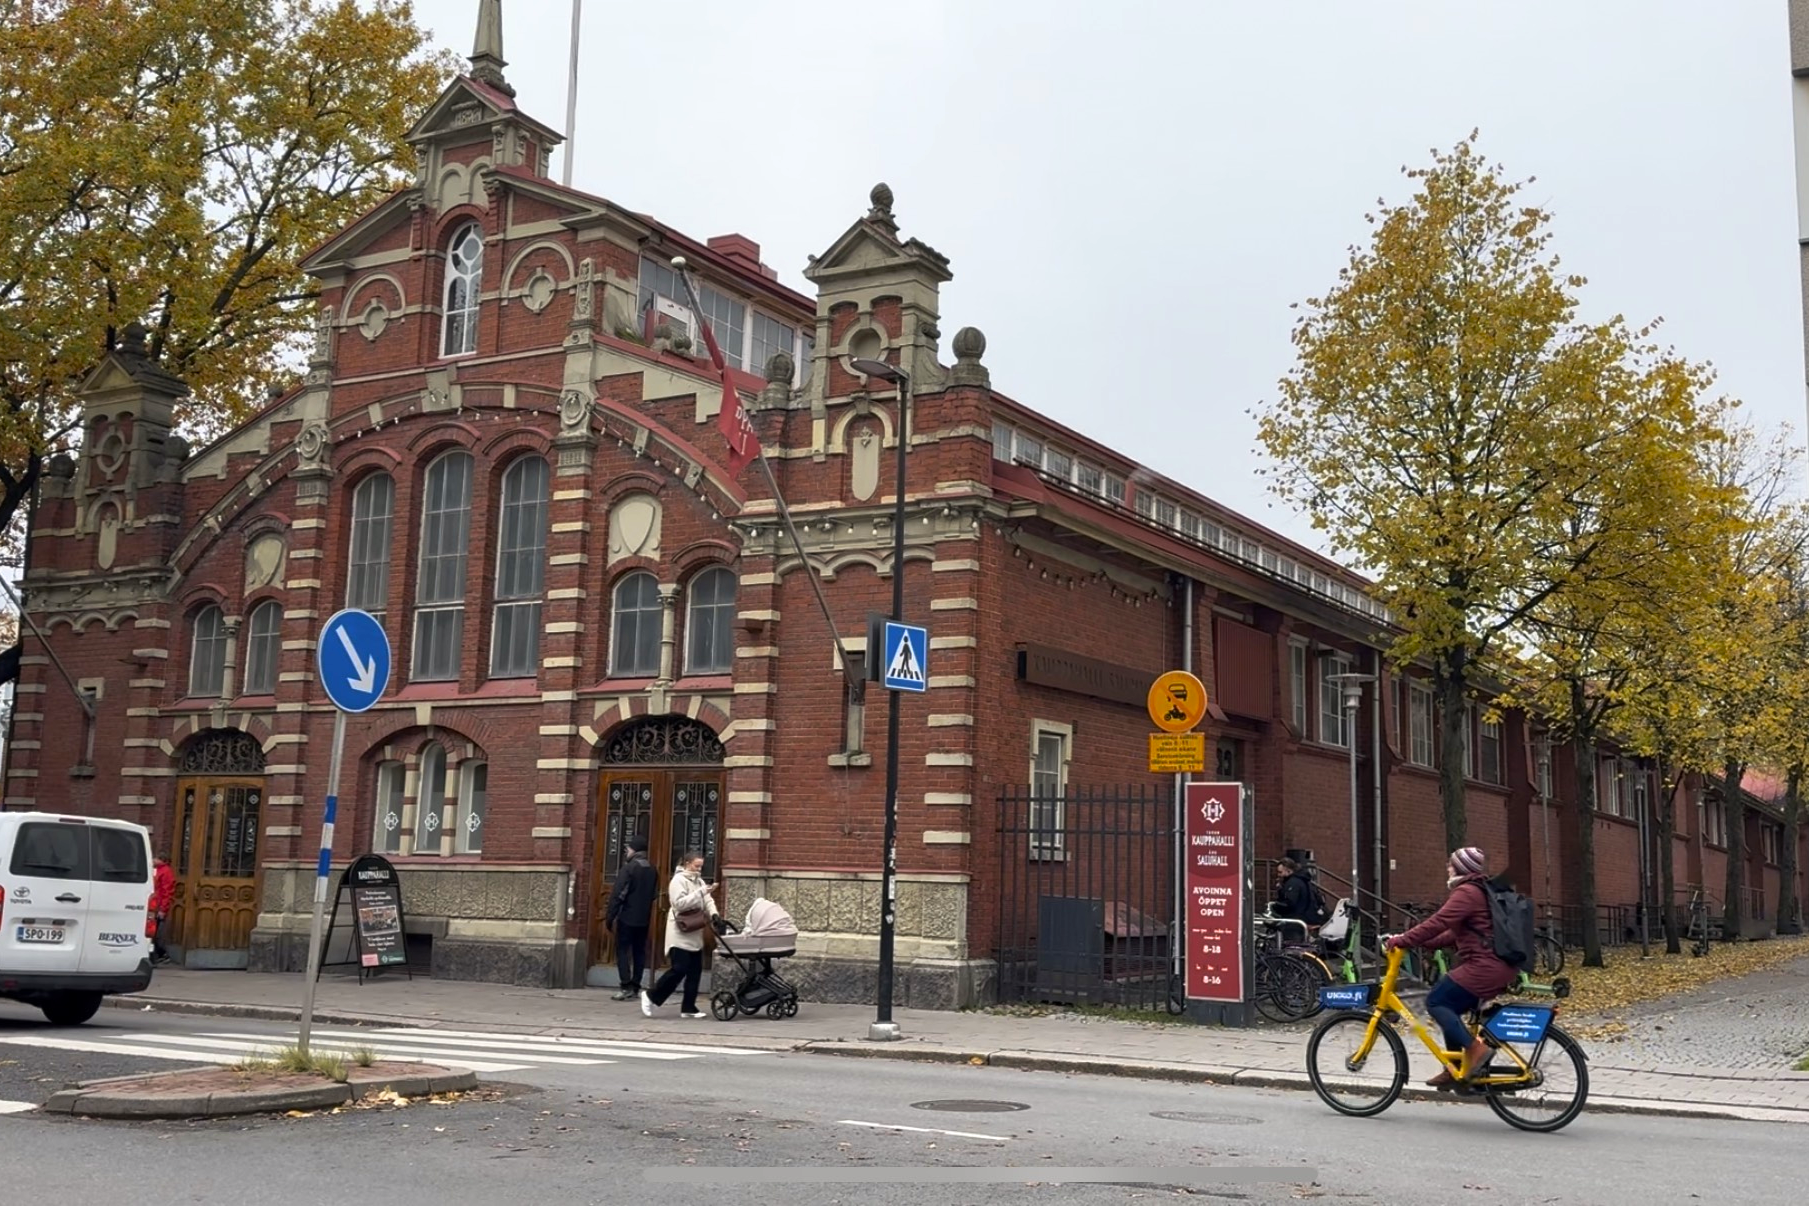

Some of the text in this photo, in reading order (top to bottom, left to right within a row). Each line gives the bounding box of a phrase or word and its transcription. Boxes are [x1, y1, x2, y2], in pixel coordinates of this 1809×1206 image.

[1191, 835, 1235, 846] KAUPPAHALLI
[1197, 855, 1228, 866] SALUHALL
[1193, 887, 1232, 895] AVOINNA
[1198, 896, 1227, 905] ÖPPET
[1200, 908, 1224, 916] OPEN
[25, 928, 63, 940] SPO-199
[98, 932, 138, 944] BERNER
[1203, 945, 1221, 953] 8-18
[1203, 975, 1221, 984] 8-16
